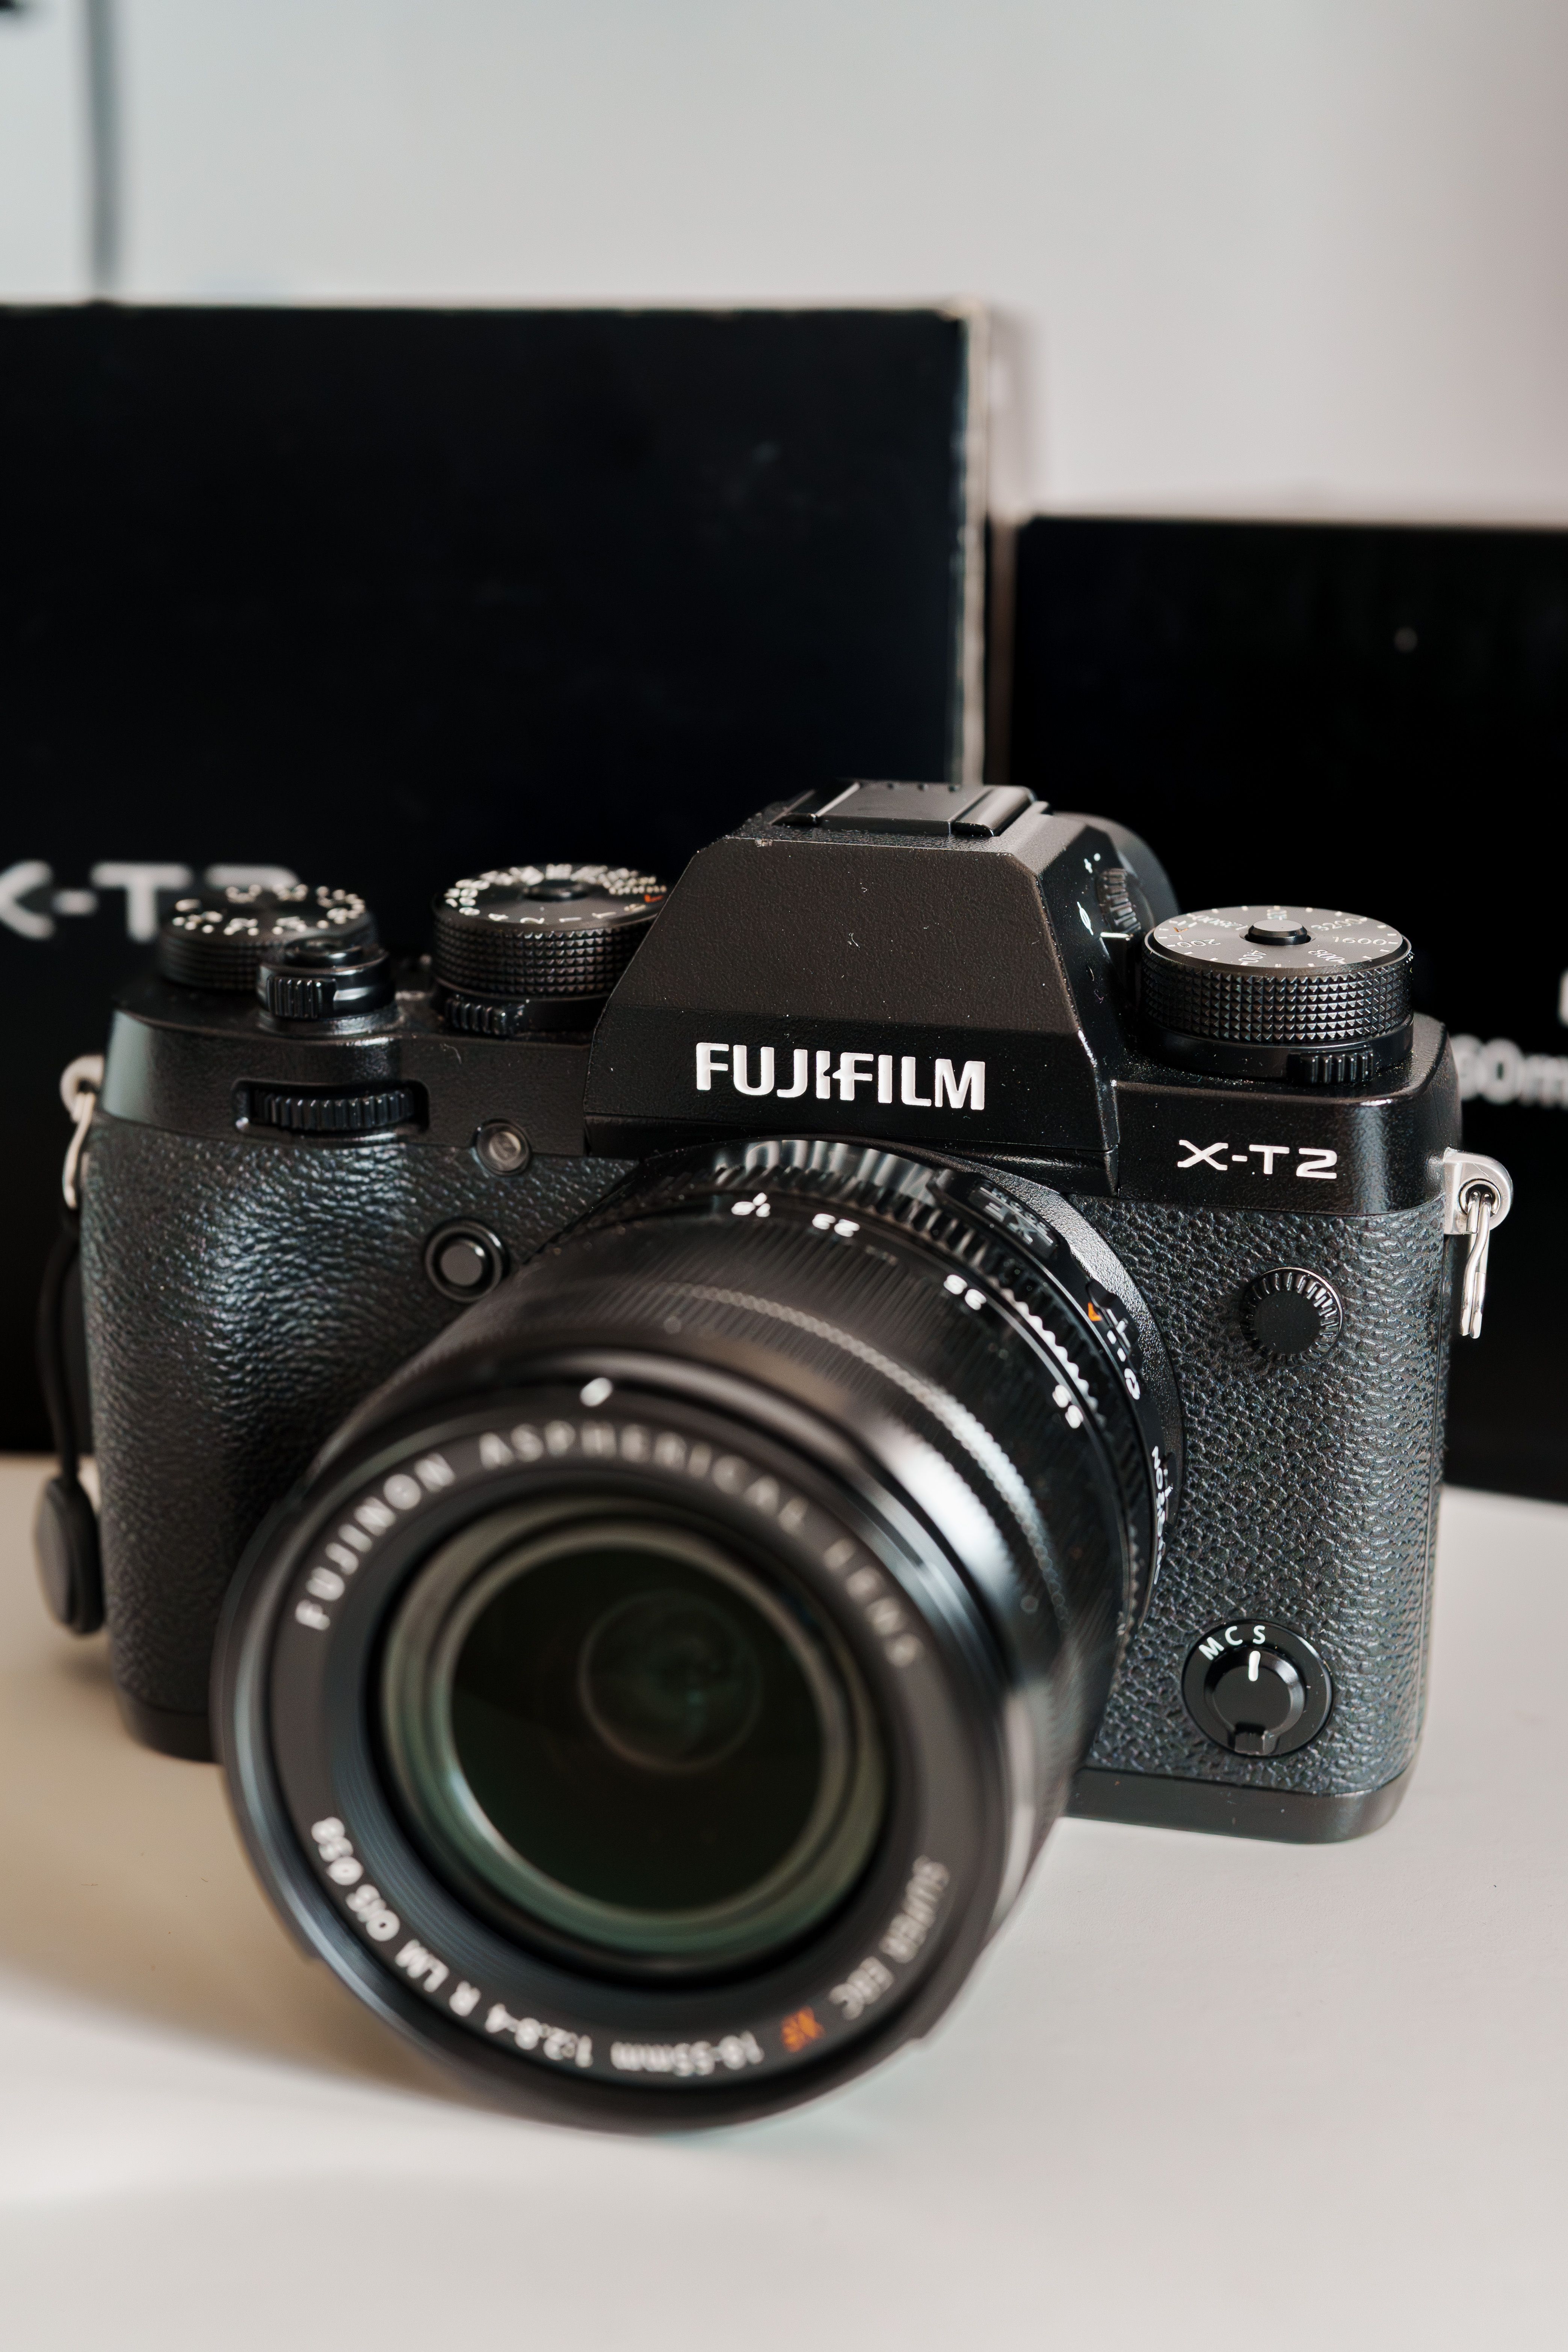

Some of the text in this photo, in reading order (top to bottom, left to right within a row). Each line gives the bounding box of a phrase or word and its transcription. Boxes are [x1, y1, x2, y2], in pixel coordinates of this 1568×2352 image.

[1311, 918, 1363, 931] 3200
[1177, 939, 1221, 948] 200
[1333, 936, 1387, 945] 1600
[1238, 950, 1267, 963] 400
[1308, 950, 1345, 962] 800
[696, 1042, 985, 1110] FUJIFILM
[1177, 1140, 1337, 1179] X-T2
[295, 1420, 924, 1668] FUJINON ASPHERICAL LENS
[1199, 1625, 1265, 1660] M C S
